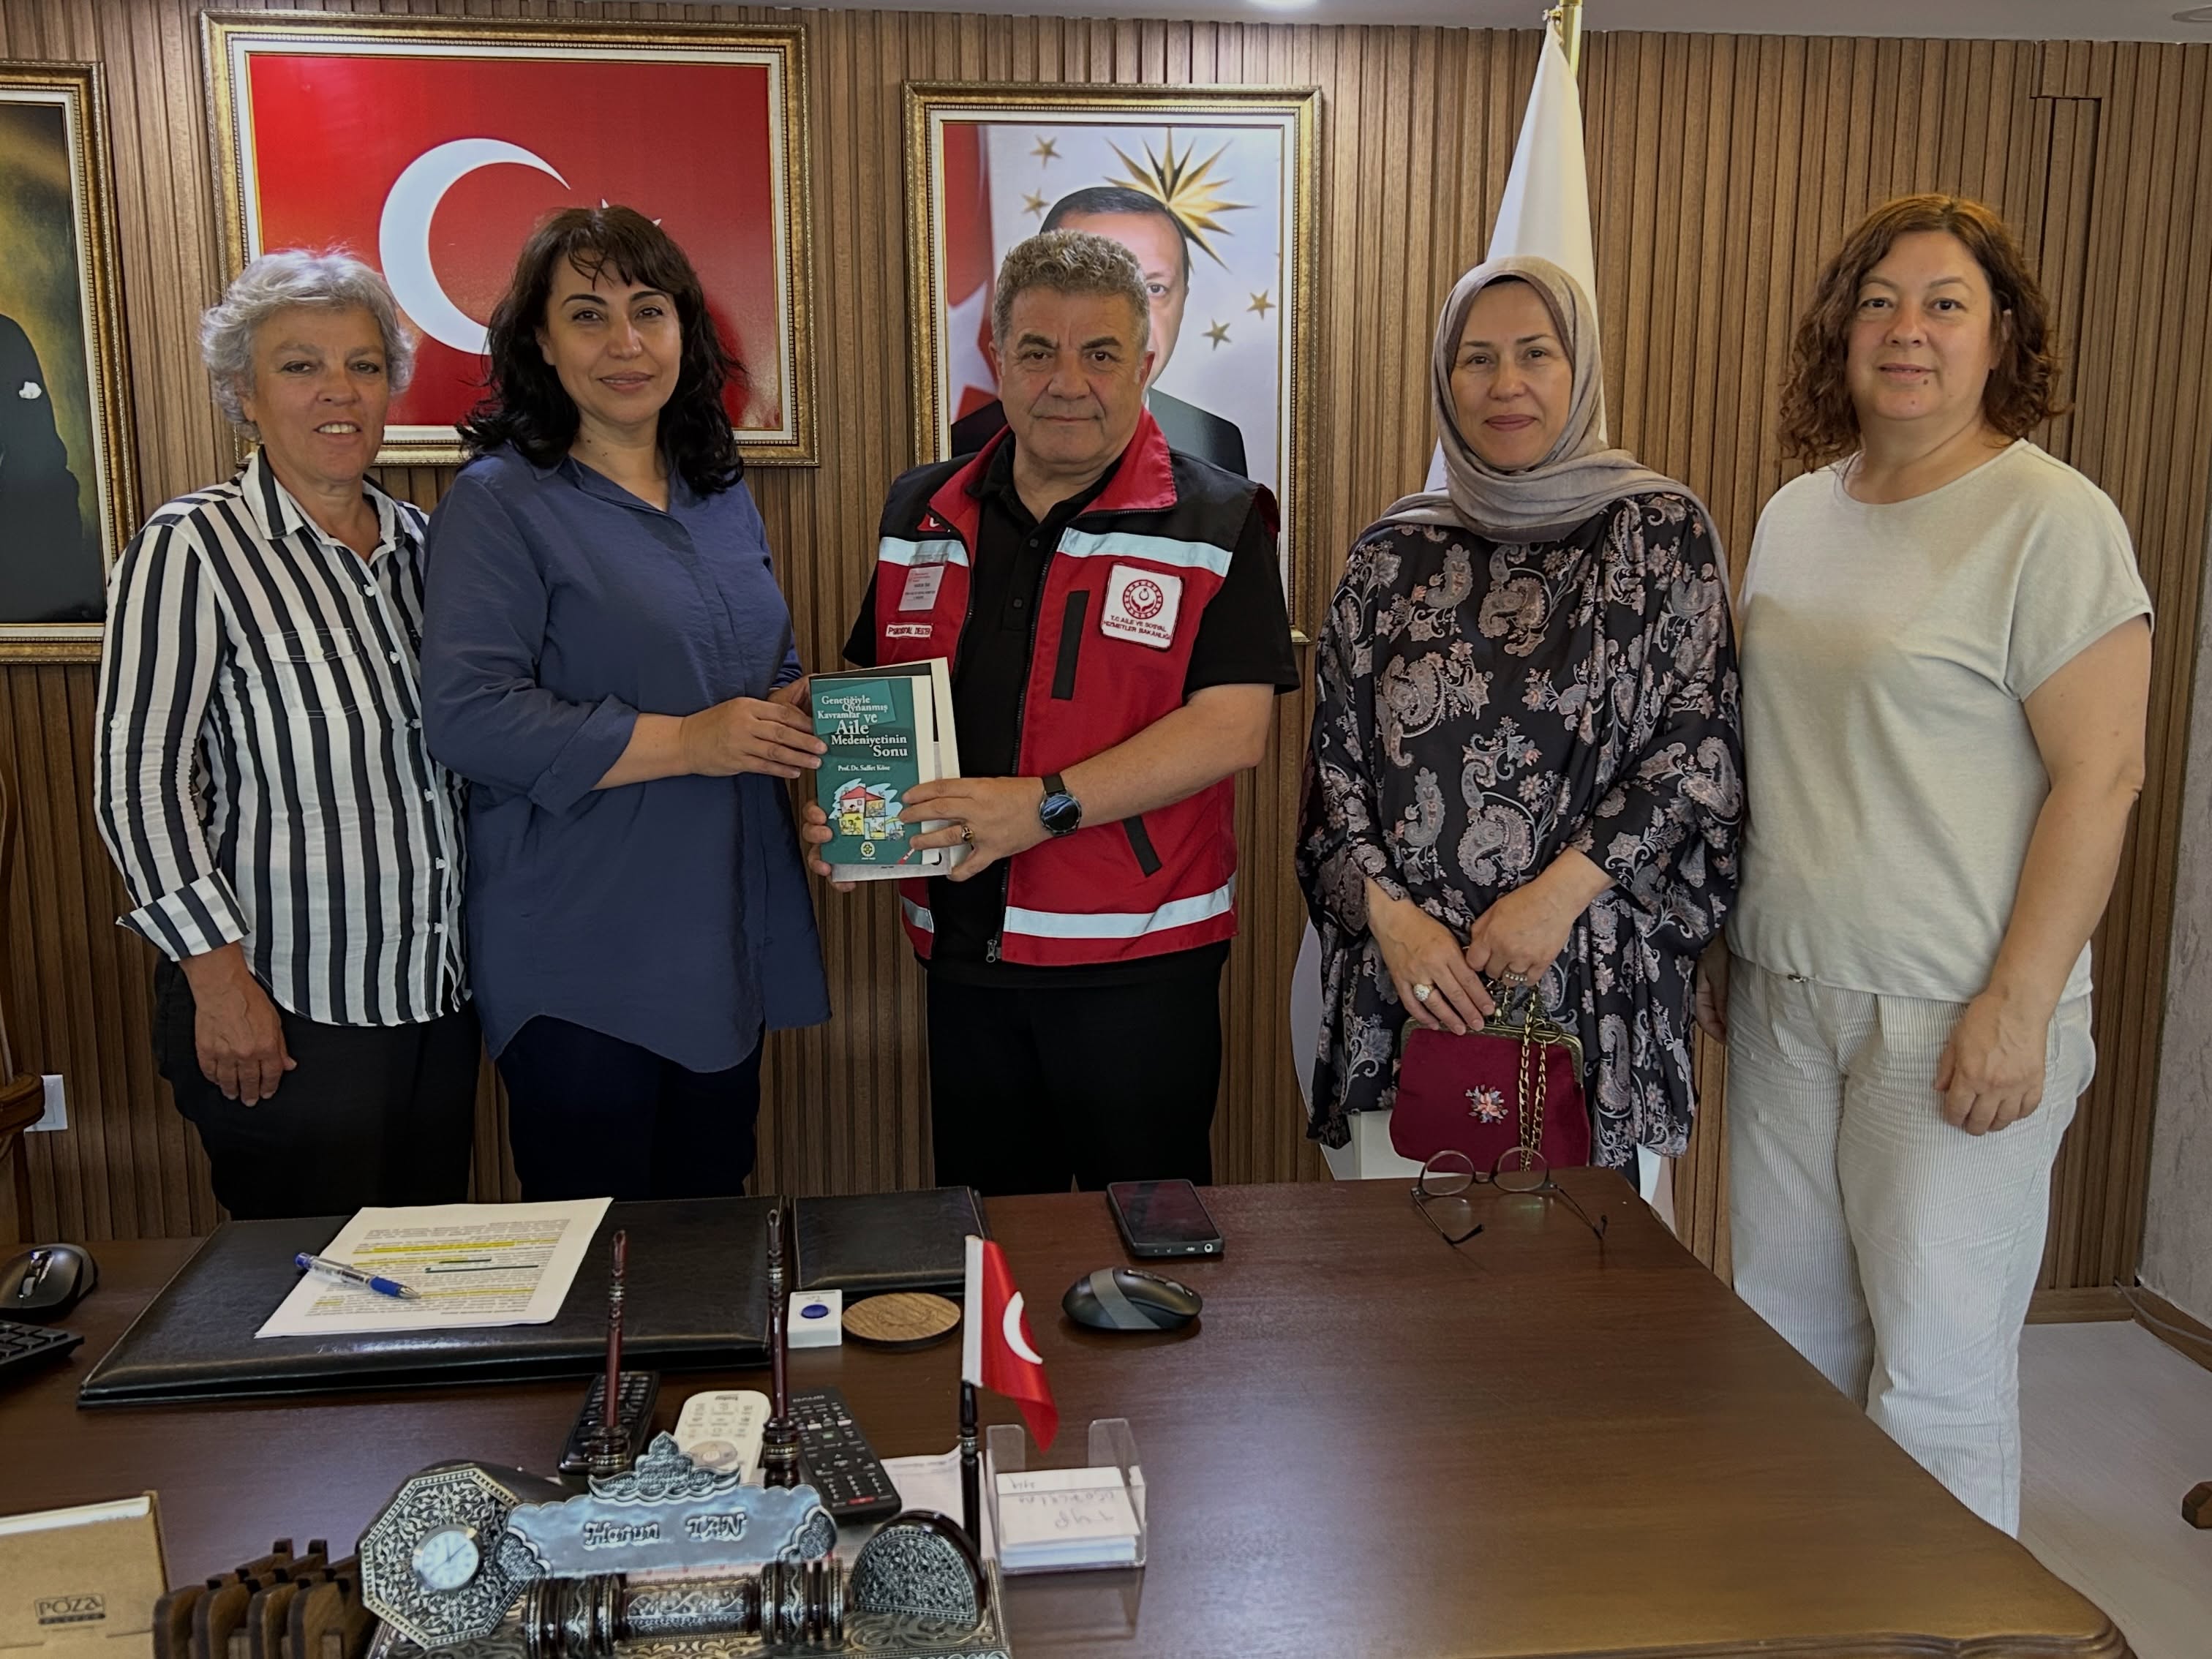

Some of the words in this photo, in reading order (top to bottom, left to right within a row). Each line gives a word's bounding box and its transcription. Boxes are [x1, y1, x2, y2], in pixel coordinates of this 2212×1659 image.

[821, 695, 870, 706] Genetiğiyle
[842, 703, 888, 712] Oynanmış
[817, 710, 860, 719] Kavramlar
[864, 713, 878, 723] ve
[835, 719, 869, 735] Aile
[831, 734, 907, 747] Medeniyetinin
[873, 745, 908, 757] Sonu
[584, 1521, 661, 1548] Harun
[684, 1512, 748, 1541] TAN
